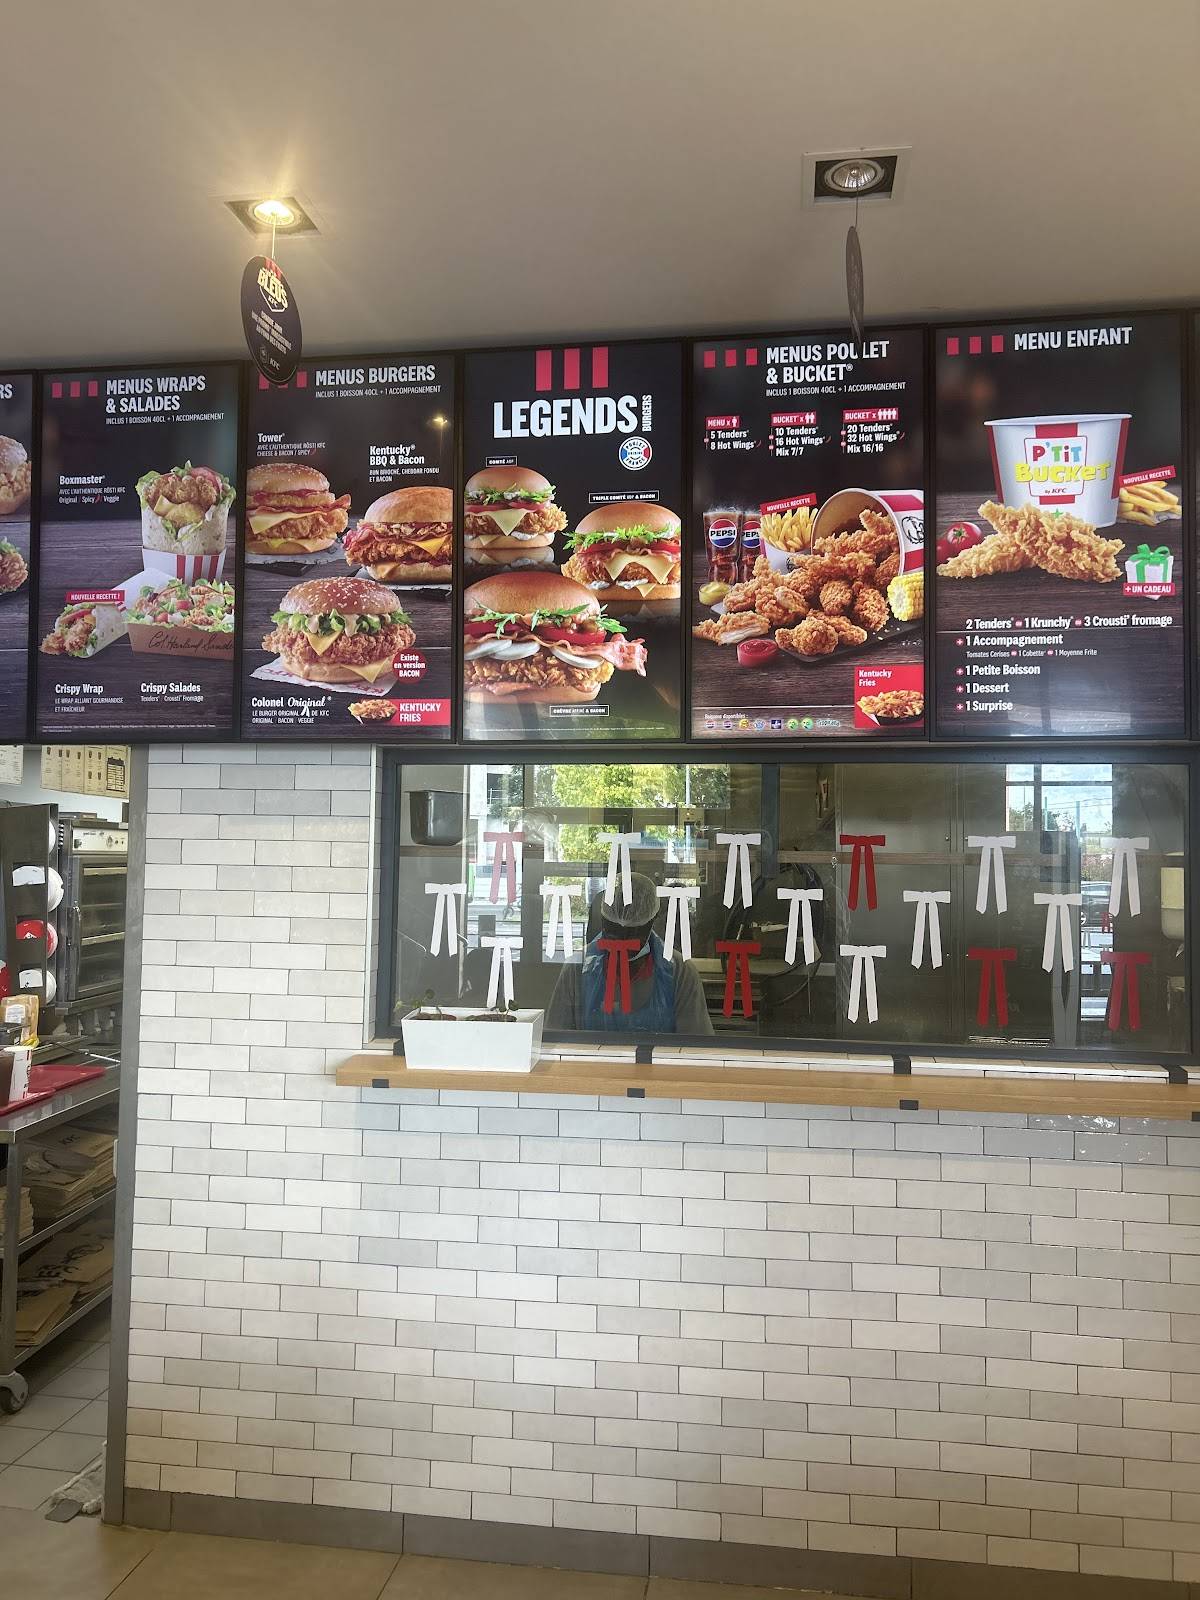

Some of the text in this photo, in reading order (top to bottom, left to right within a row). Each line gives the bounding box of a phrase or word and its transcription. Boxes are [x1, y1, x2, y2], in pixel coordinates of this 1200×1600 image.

[1014, 326, 1132, 351] MENU ENFANT
[766, 344, 822, 364] MENUS
[315, 365, 436, 386] MENUS BURGERS
[766, 367, 778, 384] &
[106, 375, 207, 395] MENUS WRAPS
[766, 388, 788, 397] INCLUS
[792, 386, 820, 396] BOISSON
[820, 385, 836, 394] 40CL
[848, 382, 907, 393] ACCOMPAGNEMENT
[315, 390, 335, 398] INCLUS
[340, 389, 364, 398] BOISSON
[364, 388, 379, 396] 40CL
[388, 385, 441, 395] ACCOMPAGNEMENT
[106, 395, 181, 414] & SALADES
[493, 394, 638, 439] LEGENDS
[641, 394, 652, 432] BURGERS
[105, 413, 225, 425] INCLUS BOISSON 40CL ACCOMPAGNEMENT
[707, 419, 726, 428] MENU
[775, 428, 784, 436] 10
[847, 424, 858, 433] 20
[710, 431, 715, 439] 5
[847, 434, 857, 442] 32
[858, 433, 873, 442] Hot
[710, 442, 715, 450] 8
[717, 441, 731, 450] Hot
[775, 438, 784, 446] 16
[786, 437, 800, 446] Hot
[775, 447, 804, 457] Mix 7/7
[847, 443, 884, 454] Mix 16/16
[369, 455, 425, 467] BBQ & Bacon
[1123, 469, 1172, 484] NOUVELLE RECETTE
[710, 529, 736, 537] PEPSI
[1132, 585, 1171, 593] UN CADEAU
[965, 619, 973, 629] 2
[1024, 618, 1029, 628] 1
[1084, 616, 1091, 627] 3
[1131, 615, 1173, 628] fromage
[965, 634, 1063, 648] 1 Accompagnement
[400, 653, 420, 662] Existe
[966, 648, 1097, 658] Tomates Cerises Moyenne Frite
[402, 661, 426, 669] version
[965, 664, 1041, 675] 1 Petite Boisson
[398, 669, 420, 678] BACON
[858, 669, 893, 678] Kentucky
[141, 681, 201, 694] Crispy Salades
[858, 678, 876, 687] Fries
[965, 682, 1010, 693] 1 Dessert
[55, 683, 104, 695] Crispy Wrap
[182, 695, 203, 703] Fromage
[251, 697, 284, 707] Colonel
[399, 702, 441, 712] KENTUCKY
[965, 700, 1014, 713] 1 Surprise
[278, 709, 300, 717] ORIGINAL
[319, 709, 330, 717] KFC
[399, 713, 422, 722] FRIES
